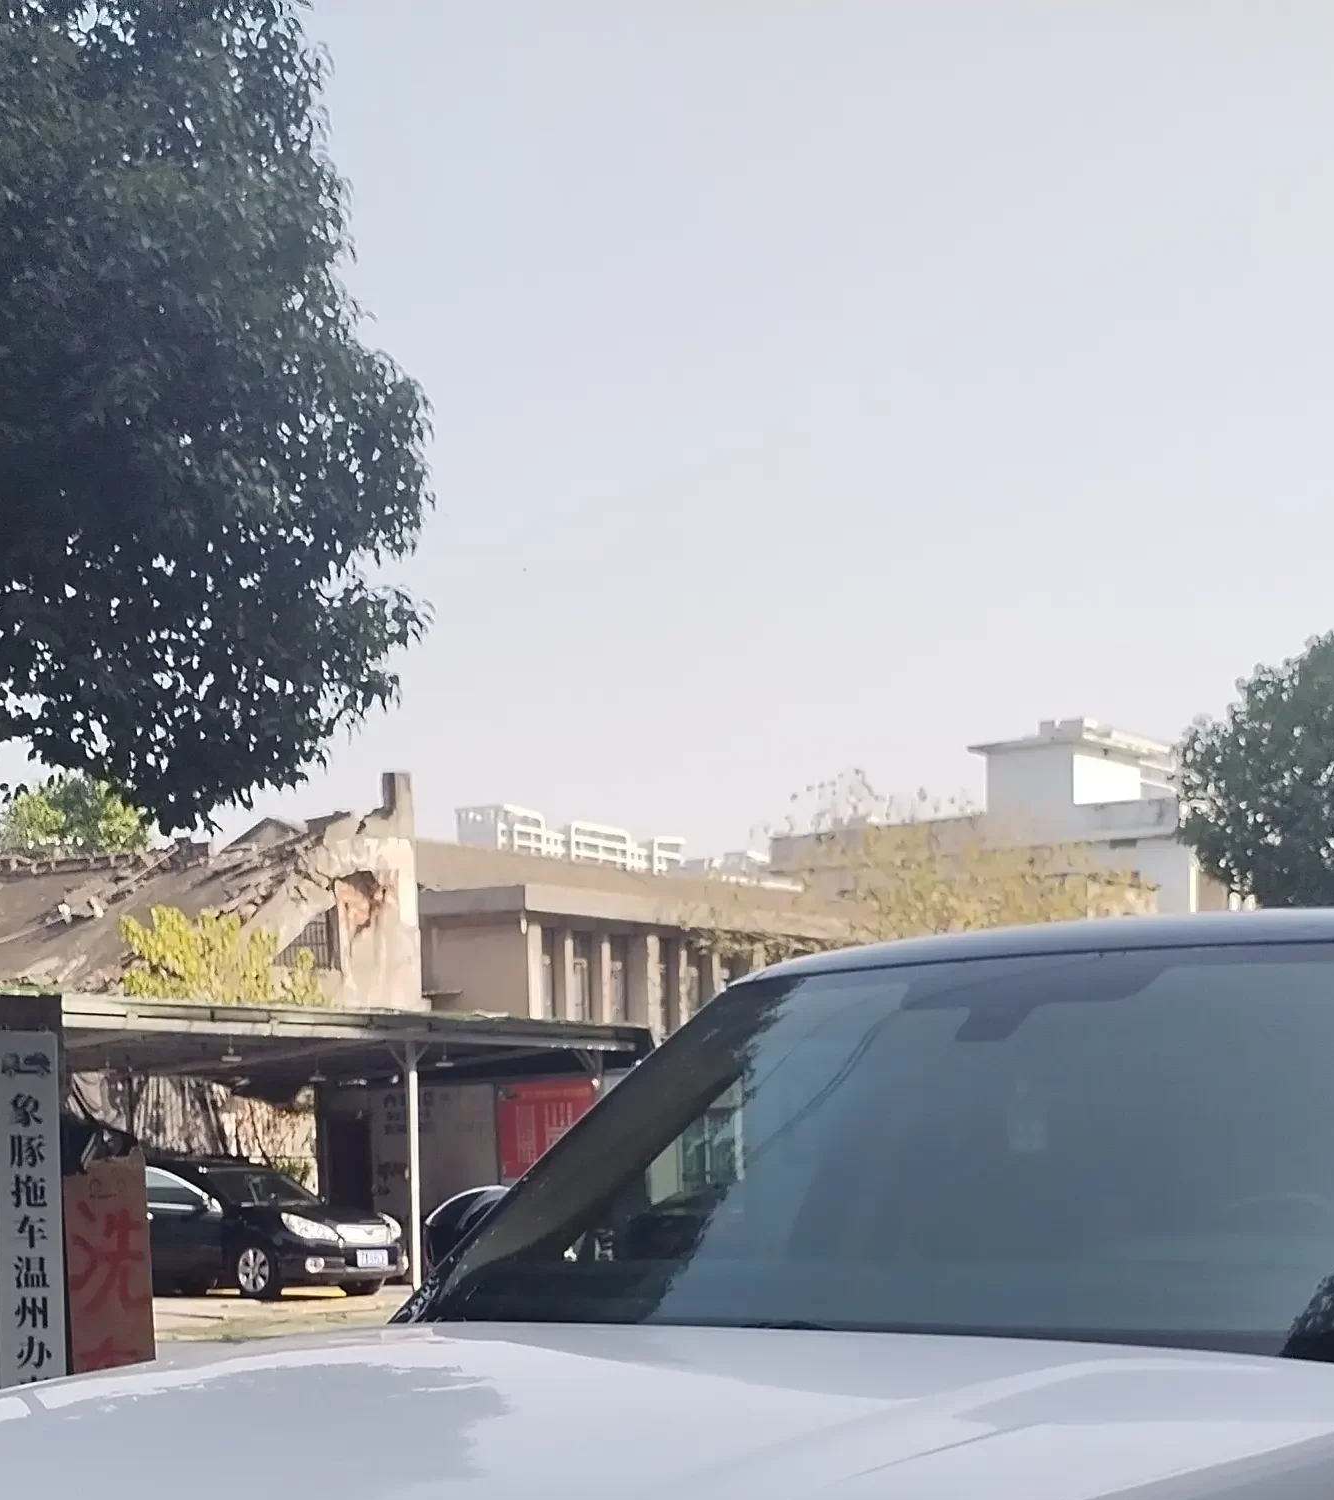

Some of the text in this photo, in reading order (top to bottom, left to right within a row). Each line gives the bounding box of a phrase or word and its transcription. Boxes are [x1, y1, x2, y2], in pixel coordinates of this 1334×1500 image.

[9, 1092, 53, 1384] 象豚拖车温州办
